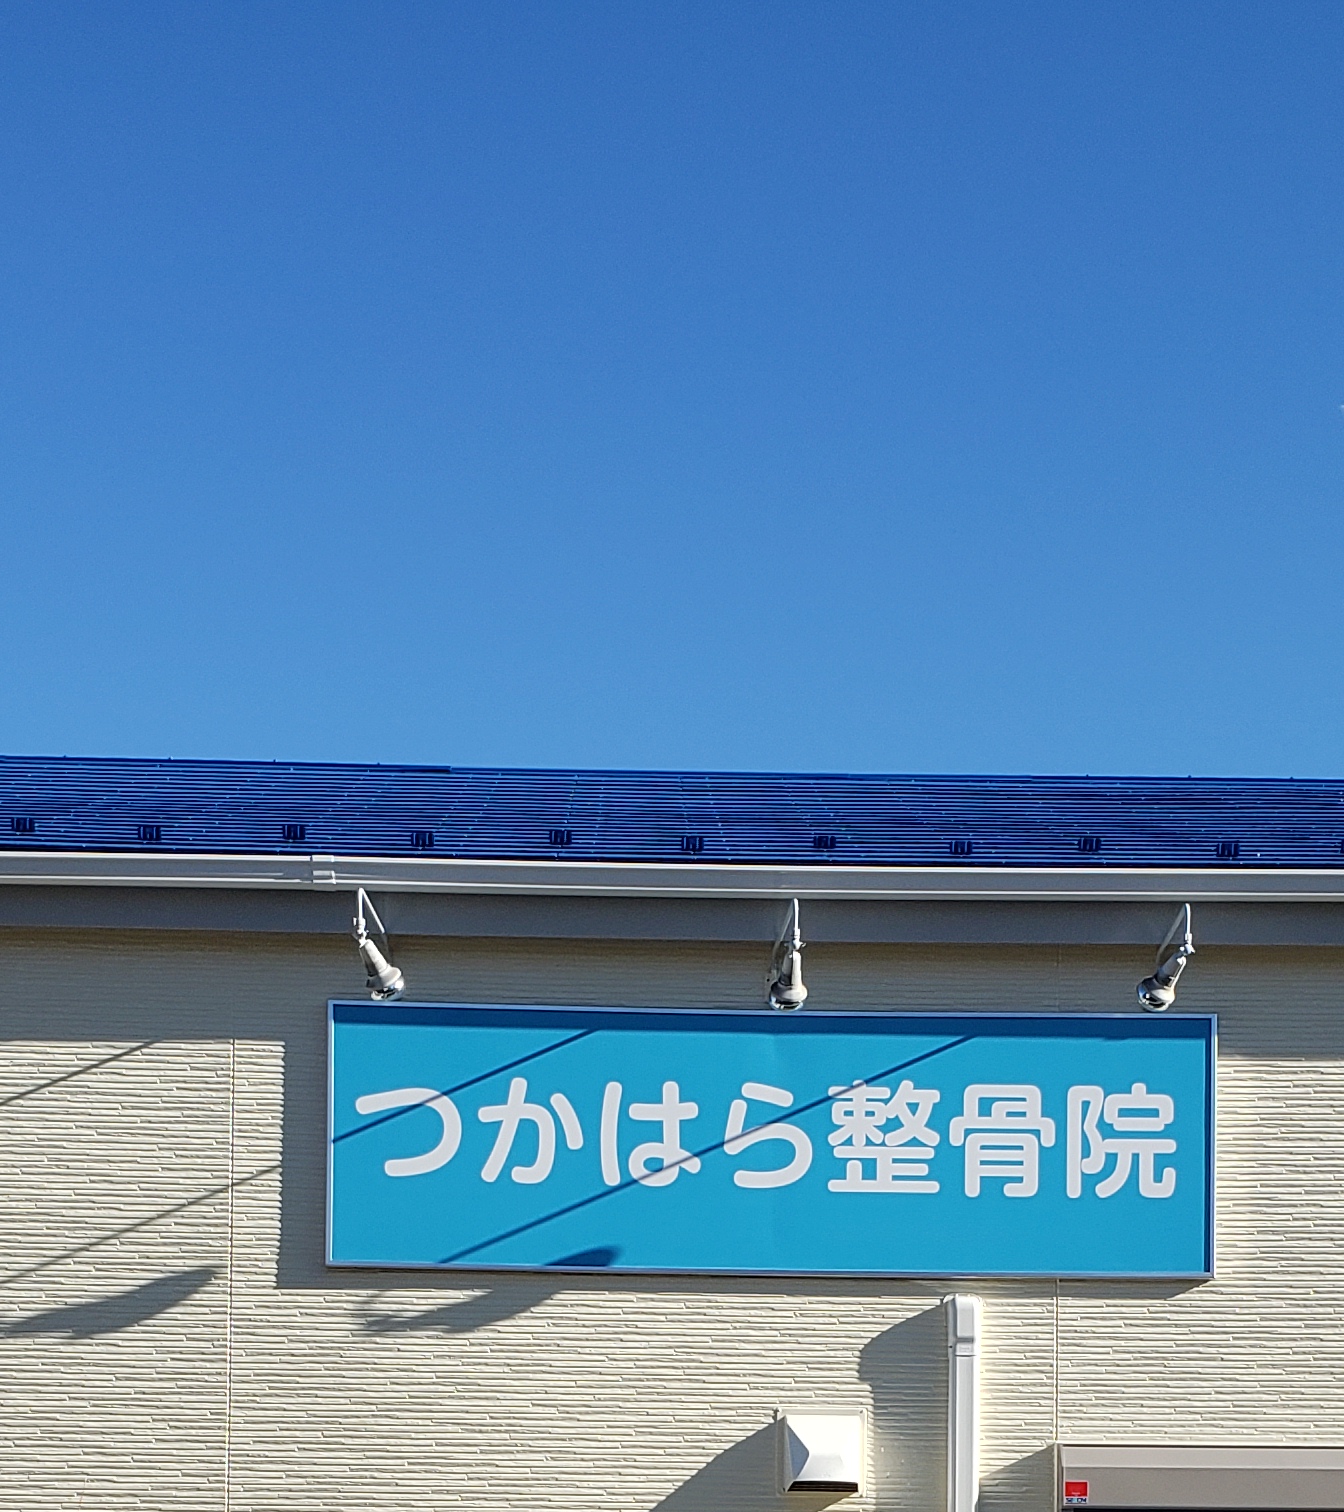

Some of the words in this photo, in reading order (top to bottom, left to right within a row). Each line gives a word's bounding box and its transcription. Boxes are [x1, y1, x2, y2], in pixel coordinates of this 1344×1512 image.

[356, 1076, 1178, 1200] つかはら整骨院
